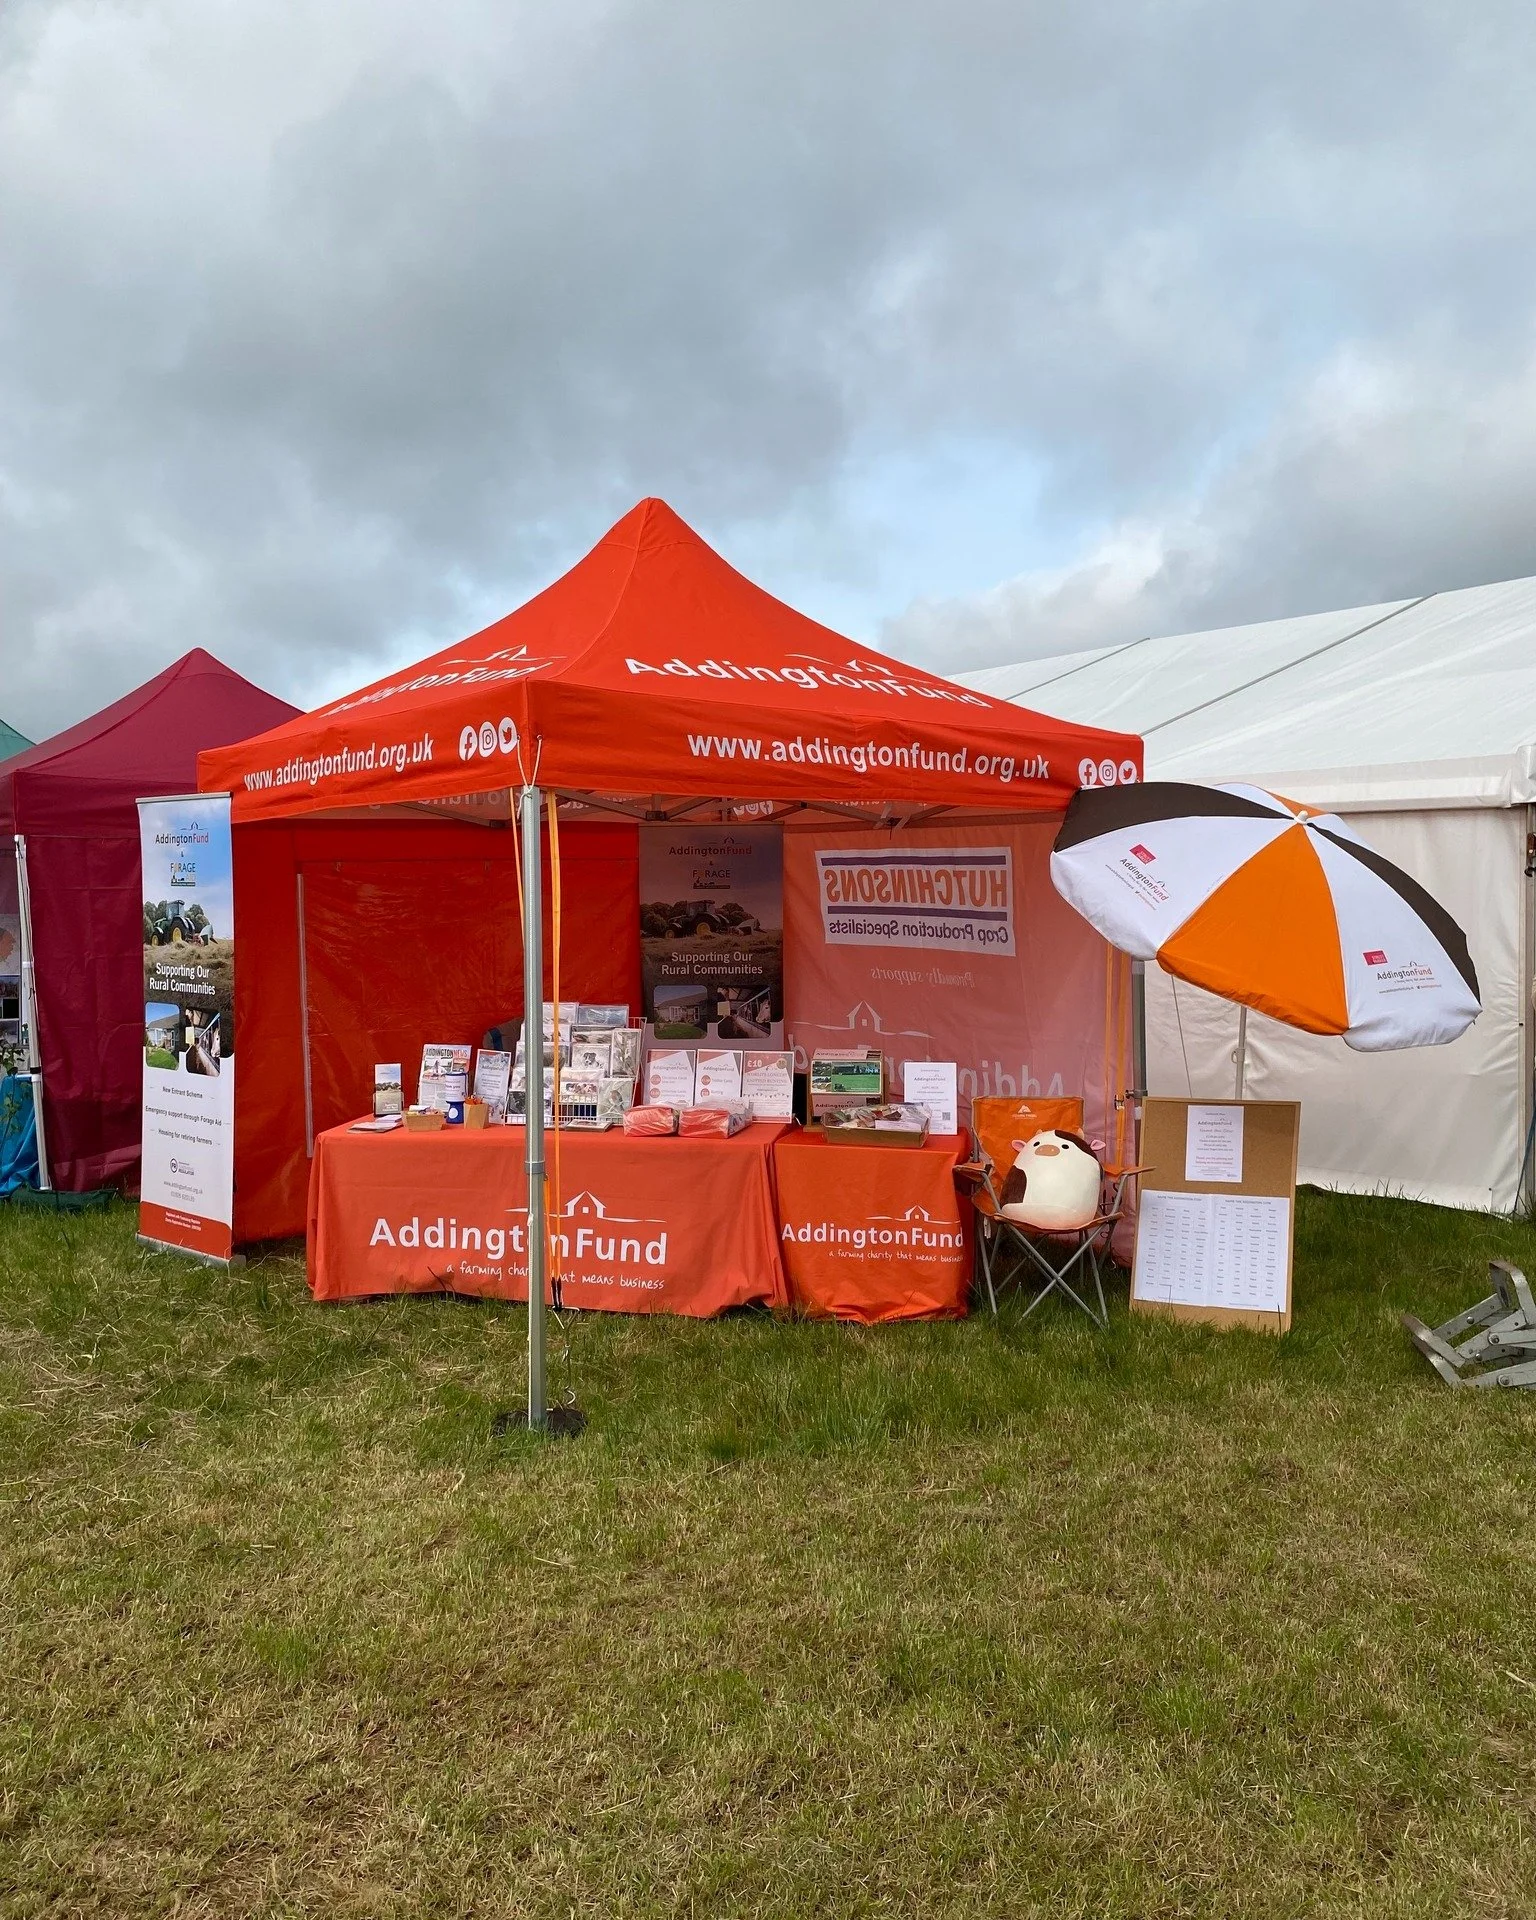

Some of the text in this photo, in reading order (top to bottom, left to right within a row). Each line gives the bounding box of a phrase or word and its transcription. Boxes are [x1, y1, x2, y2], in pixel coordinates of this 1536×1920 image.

[624, 657, 993, 708] AddingtonFund
[243, 733, 434, 791] www.addingtonfund.org.uk
[687, 734, 1050, 783] www.addingtonfund.org.uk
[155, 832, 209, 846] AddingtonFund
[668, 845, 752, 857] AddingtonFund
[692, 869, 731, 878] FRAGE
[1120, 858, 1169, 901] AddingtonFund
[671, 951, 753, 963] Supporting Our
[156, 962, 210, 980] Supporting Our
[661, 964, 763, 975] Rural Communities
[1377, 967, 1433, 980] AddingtonFund
[149, 977, 216, 996] Rural Communities
[369, 1217, 667, 1265] AddingtnFund
[781, 1222, 963, 1248] AddingtonFund
[837, 1249, 864, 1262] farming
[867, 1251, 893, 1261] charity
[896, 1251, 912, 1260] that
[915, 1254, 937, 1262] means
[446, 1264, 454, 1273] a
[460, 1261, 503, 1281] farming
[508, 1262, 530, 1276] char
[582, 1274, 614, 1285] means
[619, 1275, 664, 1290] business
